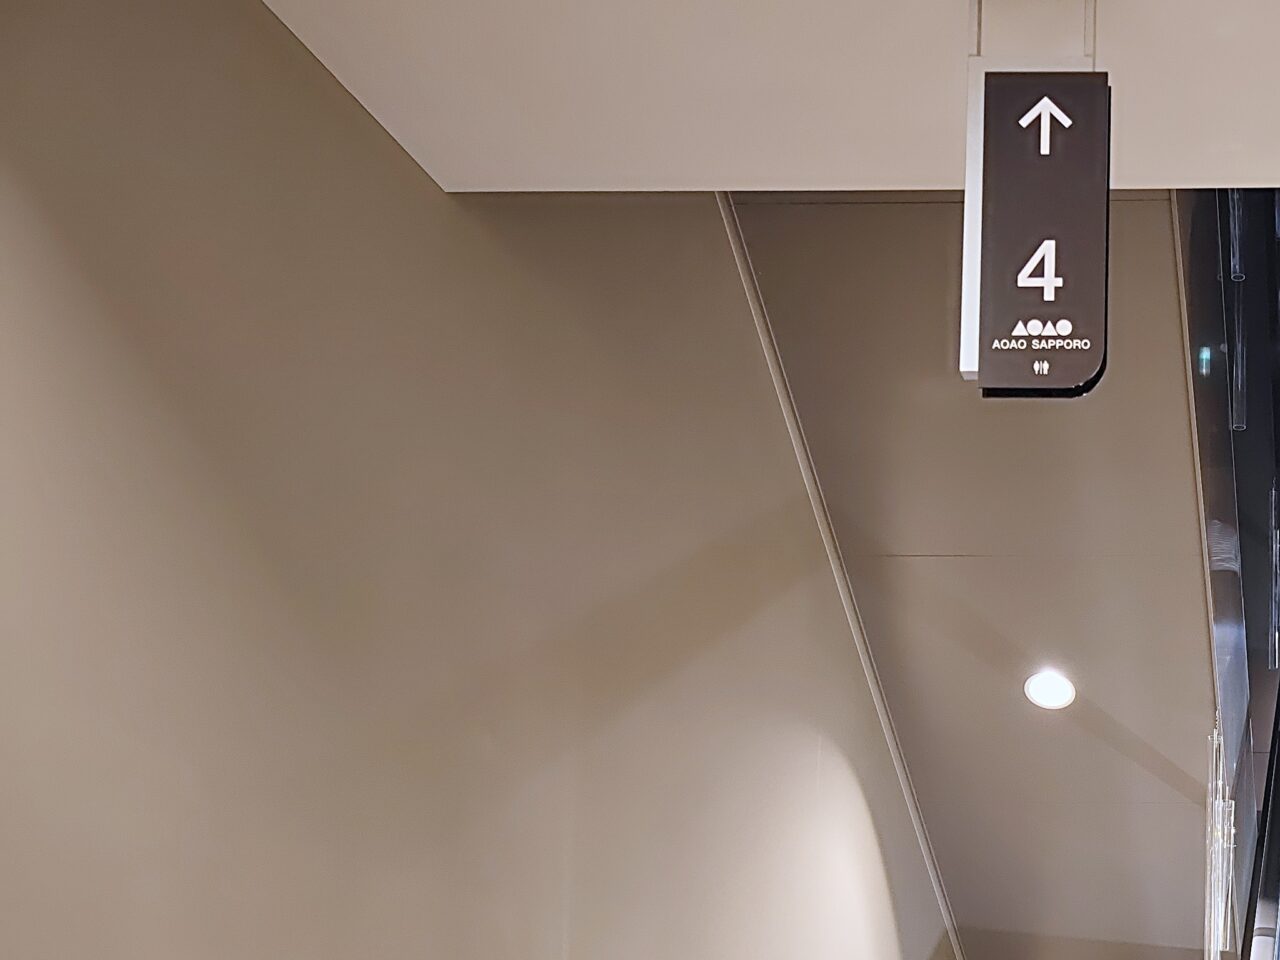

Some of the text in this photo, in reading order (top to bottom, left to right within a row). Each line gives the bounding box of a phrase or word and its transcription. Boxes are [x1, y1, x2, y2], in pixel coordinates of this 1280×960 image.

[1016, 239, 1063, 302] 4
[992, 339, 1091, 350] AOAO SAPPORO
